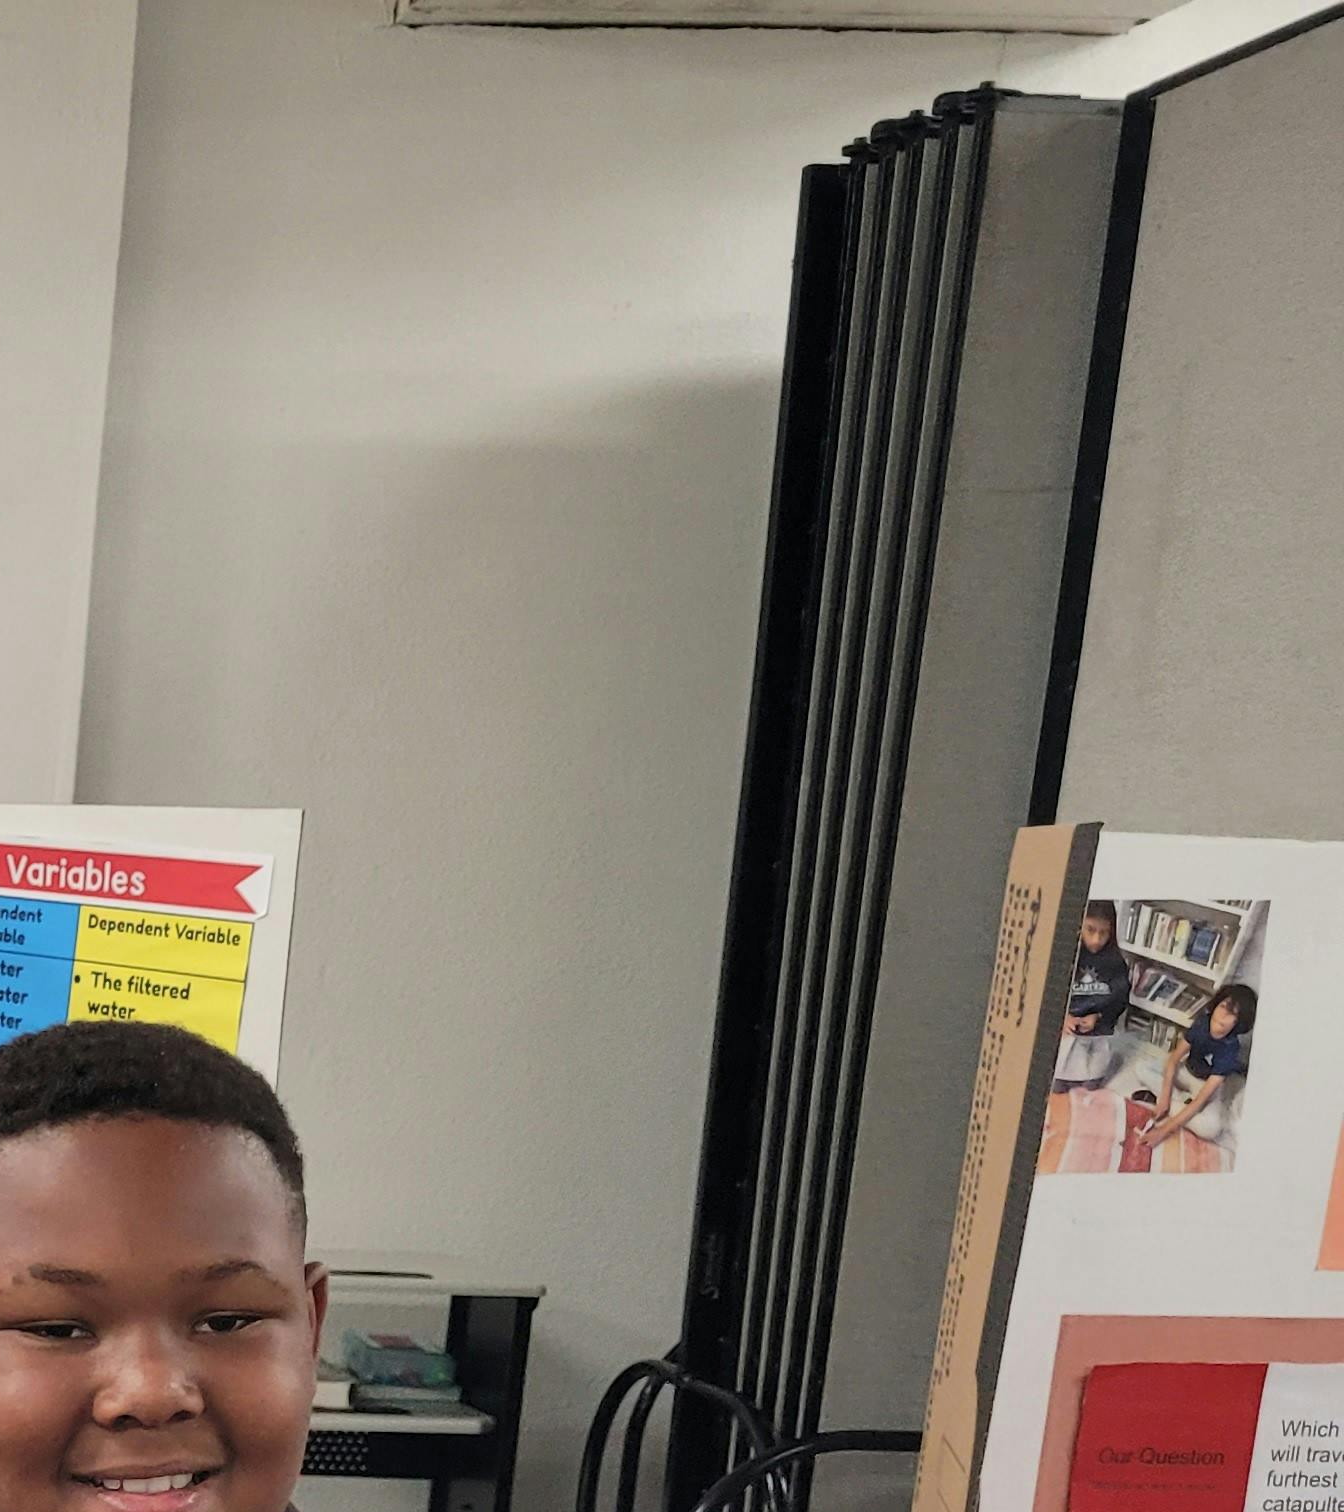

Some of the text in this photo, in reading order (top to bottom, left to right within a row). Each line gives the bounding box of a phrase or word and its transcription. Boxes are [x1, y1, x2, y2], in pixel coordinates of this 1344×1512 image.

[6, 853, 145, 897] Variables
[88, 914, 241, 947] Dependent Variable
[91, 971, 191, 1000] The filtered
[87, 1001, 136, 1021] water
[1282, 1419, 1340, 1437] Which
[1138, 1447, 1225, 1465] Question
[1271, 1445, 1344, 1463] will trav
[1267, 1470, 1338, 1488] furthest
